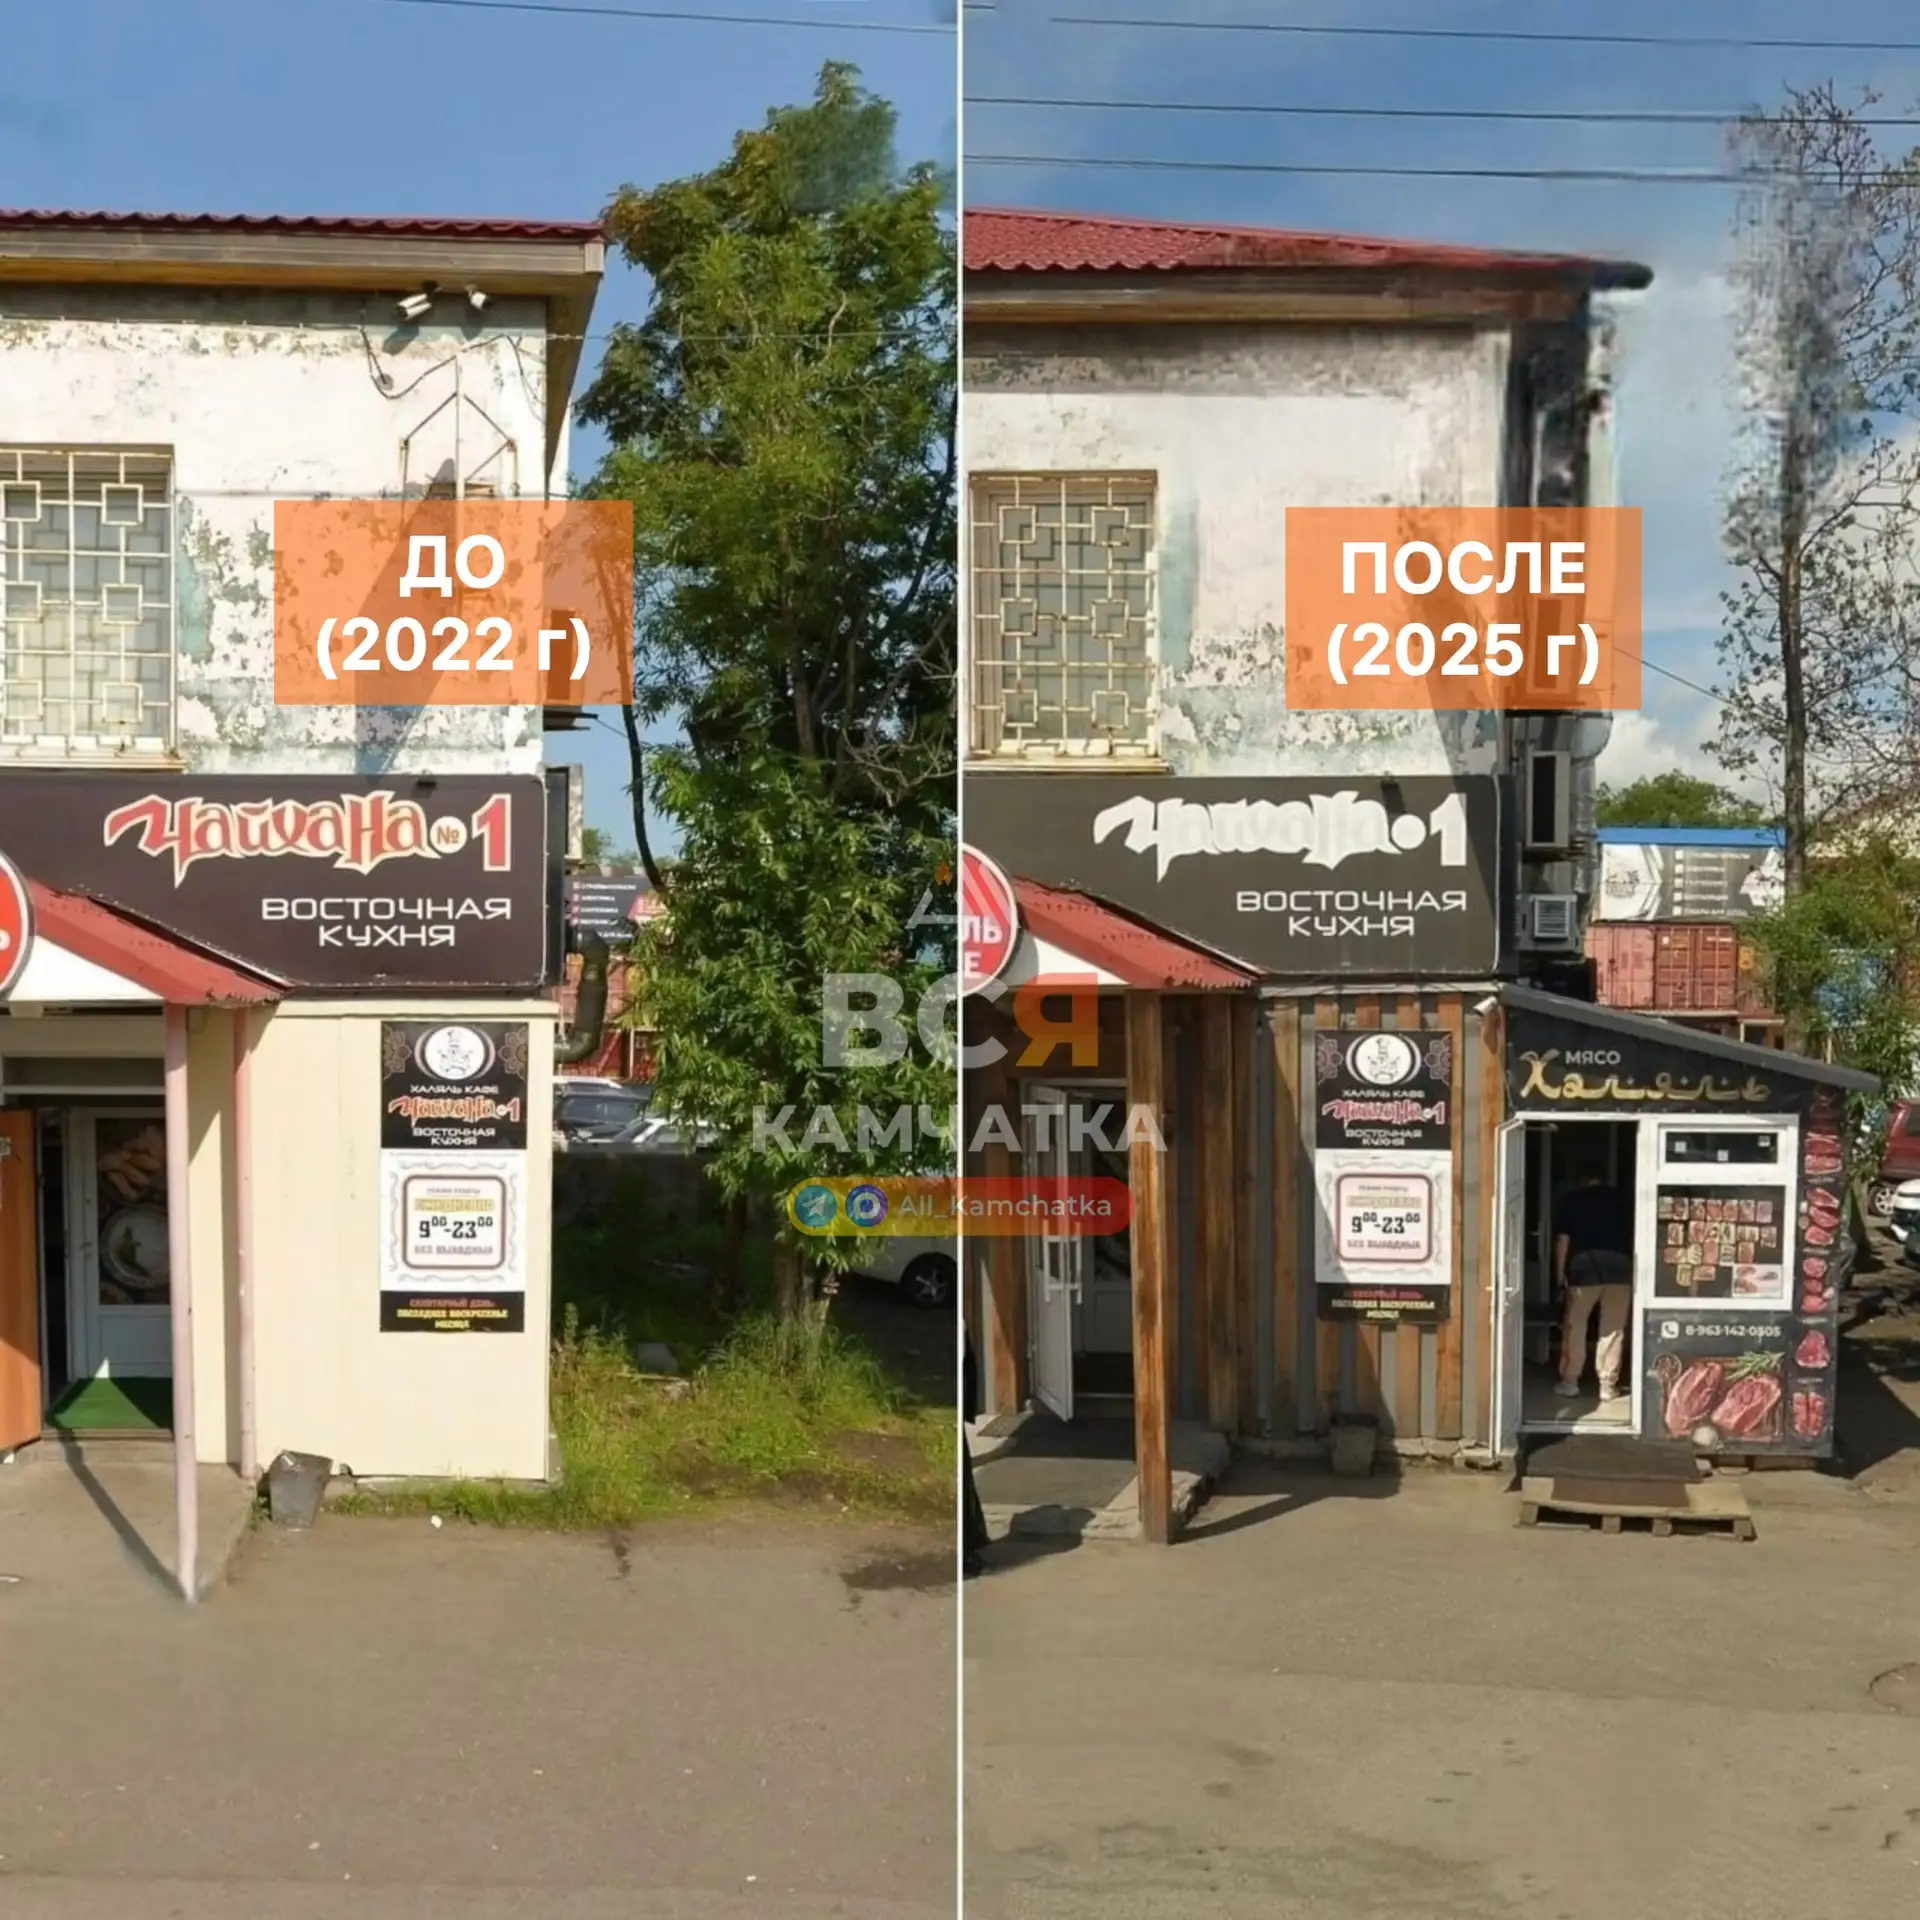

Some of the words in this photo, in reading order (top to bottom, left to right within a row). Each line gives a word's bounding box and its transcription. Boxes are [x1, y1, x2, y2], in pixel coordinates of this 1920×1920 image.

[261, 897, 512, 921] ВОСТОЧНАЯ
[1236, 890, 1468, 912] ВОСТОЧНАЯ
[318, 924, 456, 948] КУХНЯ
[1287, 915, 1416, 937] КУХНЯ
[1565, 1050, 1621, 1065] МЯСО
